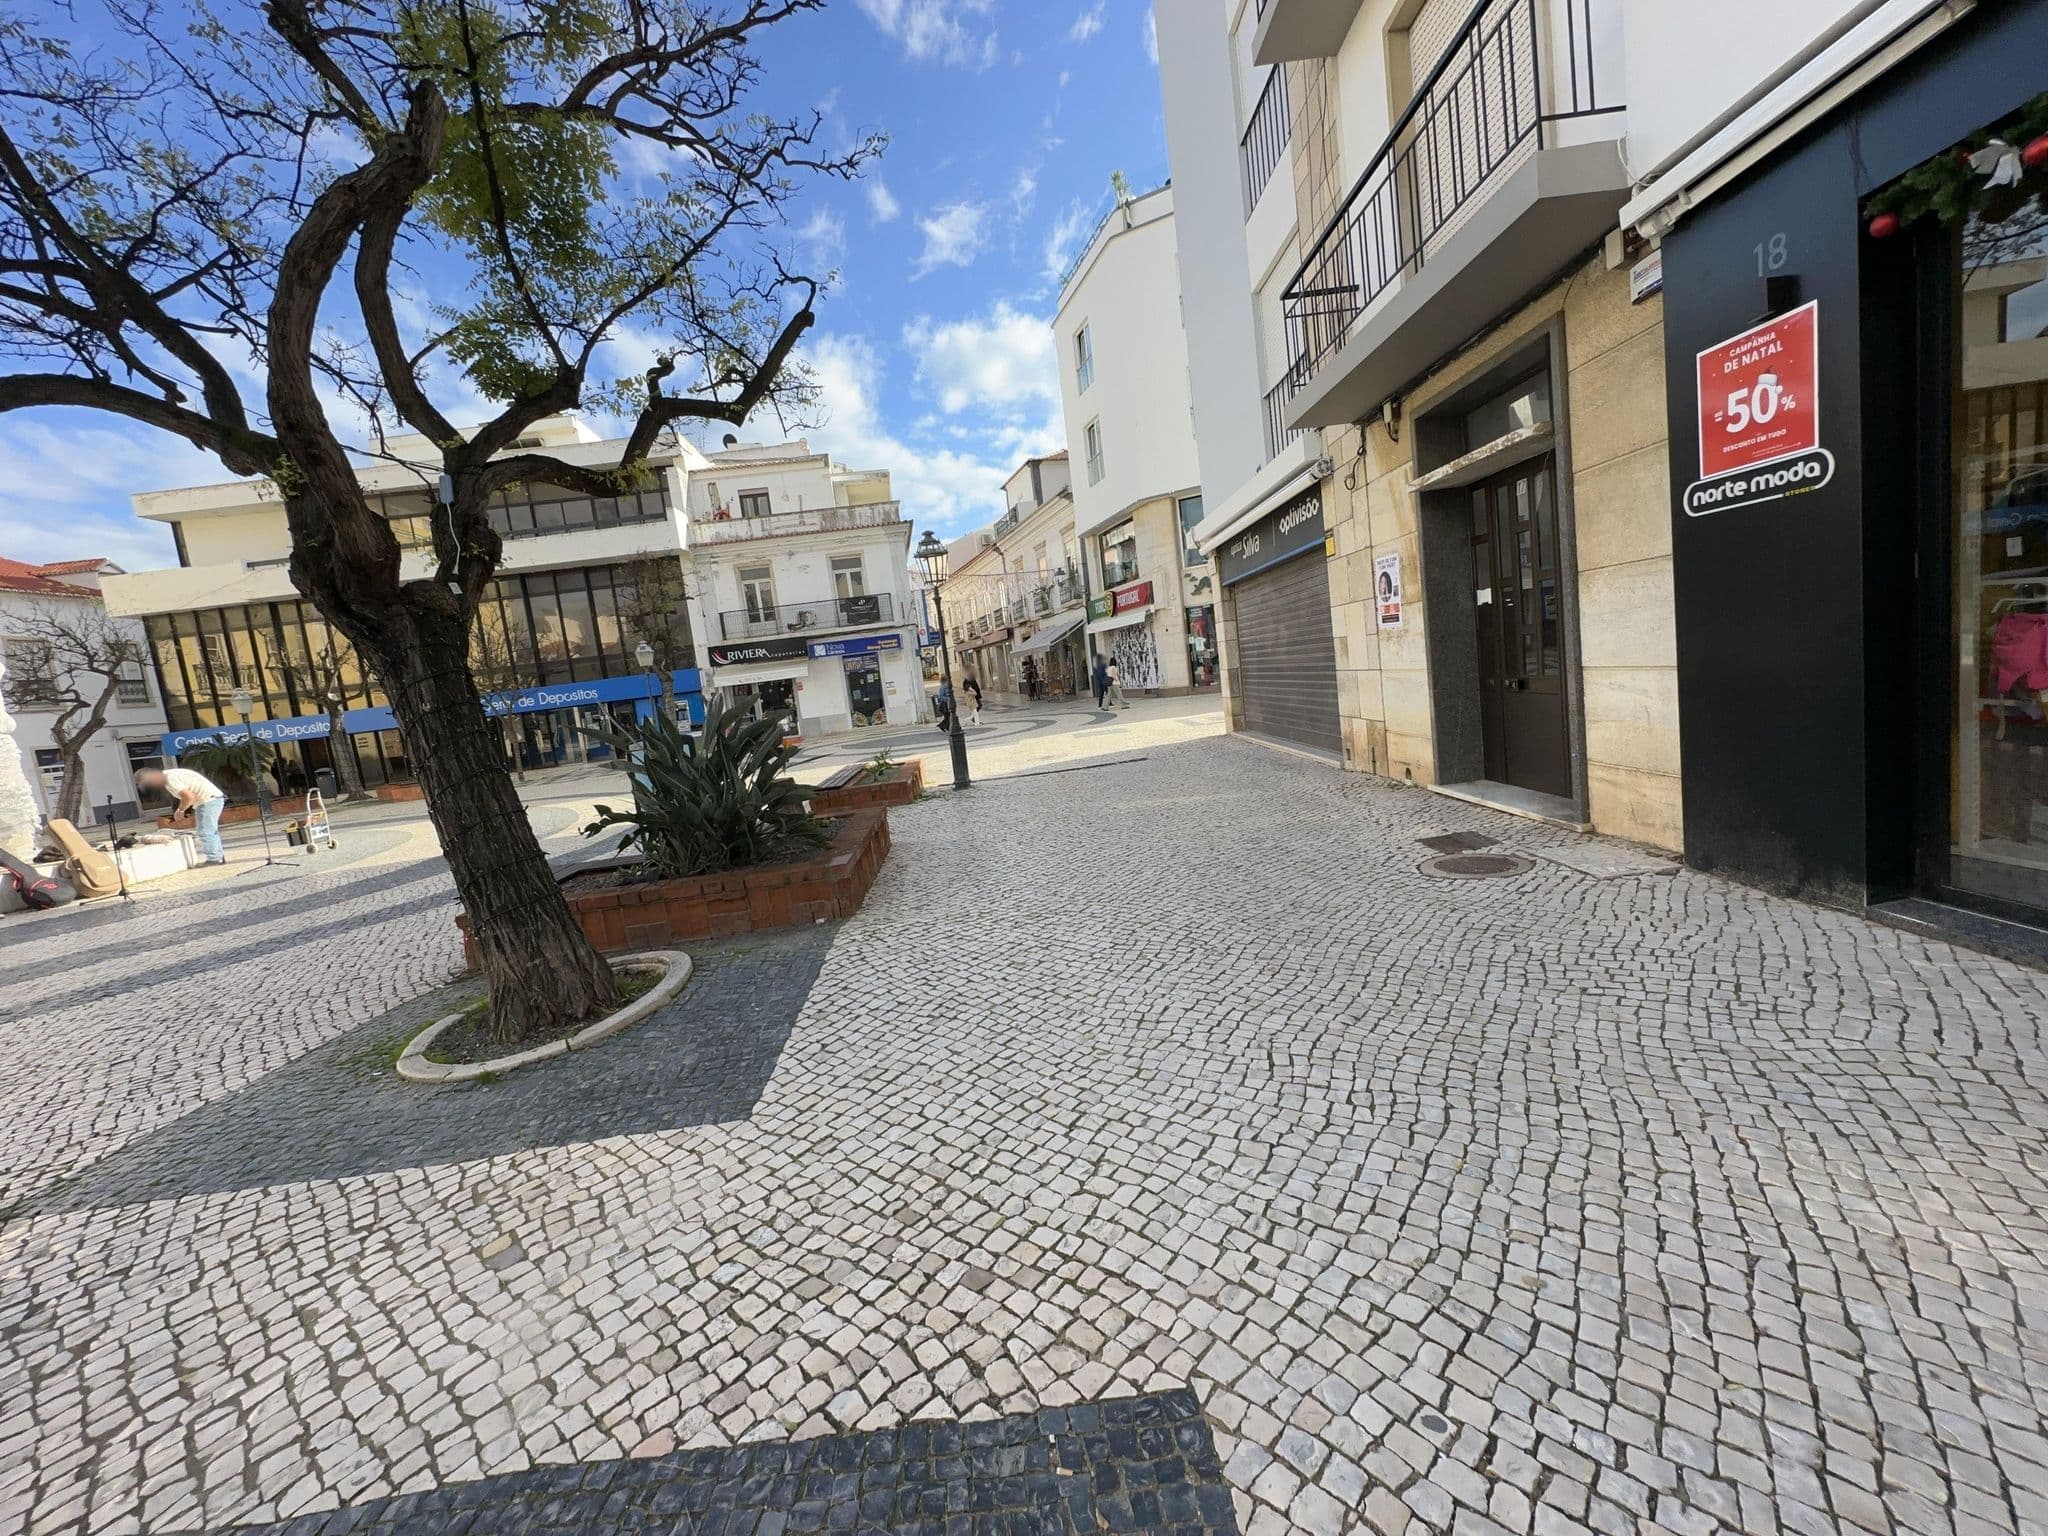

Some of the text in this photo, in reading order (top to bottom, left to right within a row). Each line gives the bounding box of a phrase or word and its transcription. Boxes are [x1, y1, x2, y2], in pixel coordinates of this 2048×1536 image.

[1753, 232, 1788, 277] 18
[1729, 332, 1776, 356] CAMPANHA
[1724, 340, 1783, 374] DE NATAL
[1722, 436, 1756, 453] DESCONTO
[1767, 428, 1787, 440] TUDO
[1692, 461, 1821, 507] norte moda
[1279, 497, 1320, 535] optivisão
[1242, 532, 1260, 559] Silva
[1116, 590, 1140, 608] PORTUGAL
[727, 648, 772, 661] RIVIERA
[518, 696, 535, 708] de
[256, 727, 273, 740] de
[276, 721, 331, 738] Deposito
